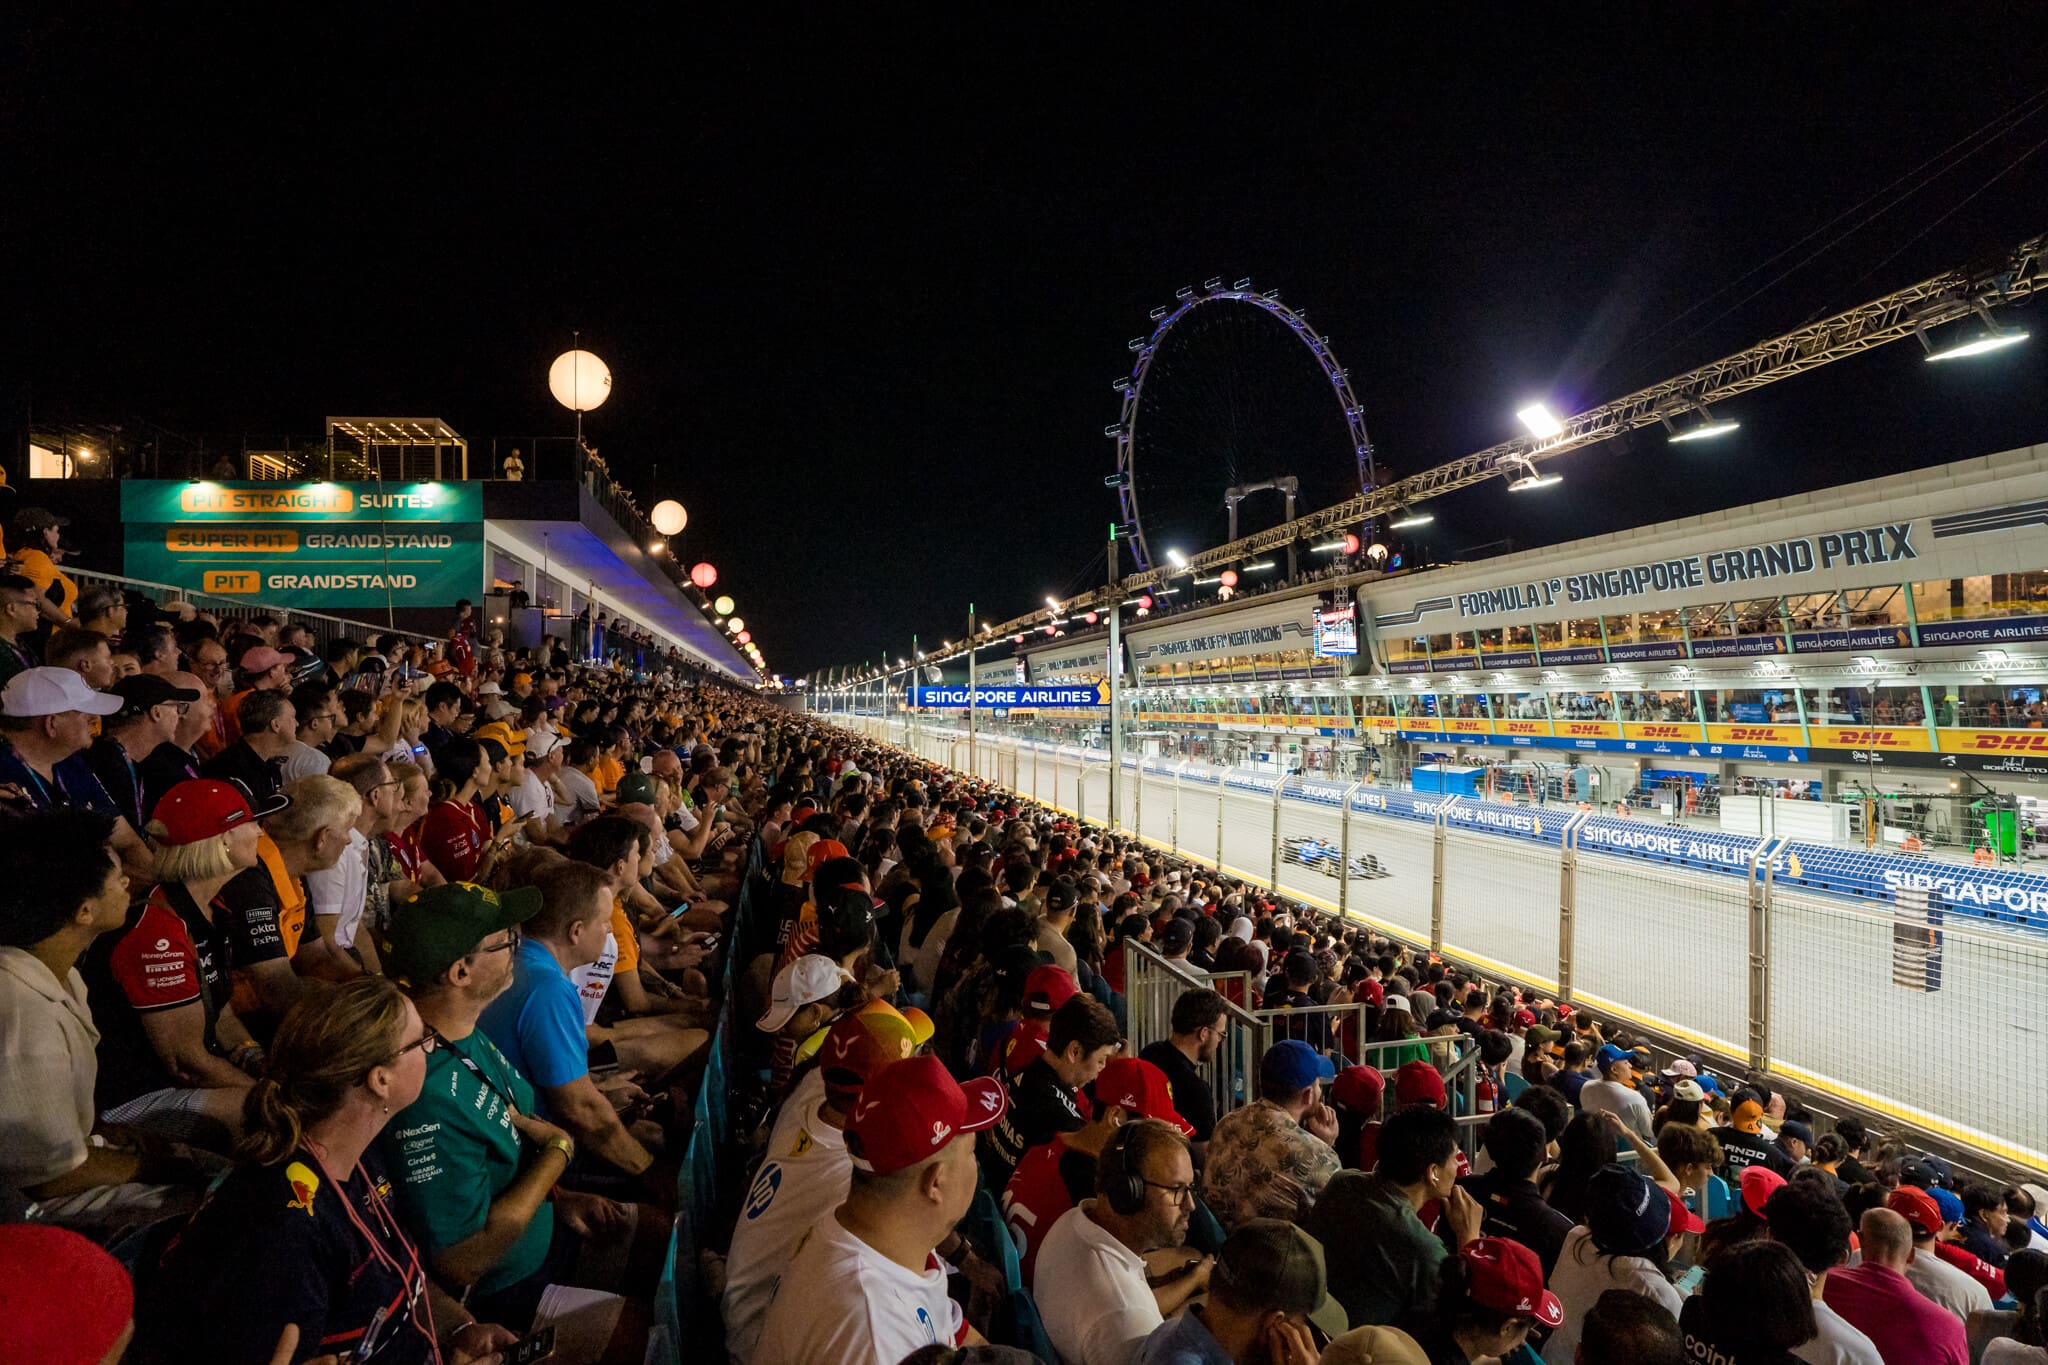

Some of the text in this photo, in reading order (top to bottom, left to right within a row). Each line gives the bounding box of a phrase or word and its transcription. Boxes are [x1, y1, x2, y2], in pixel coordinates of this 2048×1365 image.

[193, 494, 434, 508] PIT STRAIGHT SUITES
[178, 533, 452, 548] SUPER PIT GRANDSTAND
[1459, 583, 1541, 616] FORMULA
[1566, 555, 1704, 604] SINGAPORE
[1707, 537, 1815, 585] GRAND
[1819, 522, 1917, 569] PRIX
[214, 575, 417, 589] PIT GRANDSTAND
[1208, 634, 1217, 650] OF
[1228, 631, 1251, 647] NIGHT
[1251, 625, 1283, 644] RACING
[1923, 626, 2048, 642] SINGAPORE AIRLINES
[1695, 642, 1774, 655] SINGAPORE AIRLINES
[1796, 635, 1895, 649] SINGAPORE AIRLINES
[1543, 652, 1597, 664] SINGAPORE AIRLINES
[1612, 648, 1677, 660] SINGAPORE AIRLINES
[926, 690, 1092, 704] SINGAPORE AIRLINES
[1456, 722, 1480, 730] DHL
[1509, 724, 1536, 733] DHL
[1571, 725, 1602, 735] DHL
[1643, 726, 1682, 738] DHL
[1731, 728, 1779, 741] DHL
[1839, 731, 1898, 745] DHL
[1975, 734, 2048, 749] DHL
[1302, 785, 1342, 800] SINGAPORE
[1475, 809, 1531, 831] AIRLINES
[1584, 826, 1682, 854] SINGAPORE
[250, 923, 277, 936] okta
[141, 951, 184, 960] MoneyGram
[145, 960, 185, 973] PIRELLI
[580, 989, 594, 999] Red
[979, 1090, 1000, 1112] 44
[401, 1122, 441, 1139] NexGen
[1729, 1153, 1750, 1165] 04
[747, 1165, 781, 1213] hp
